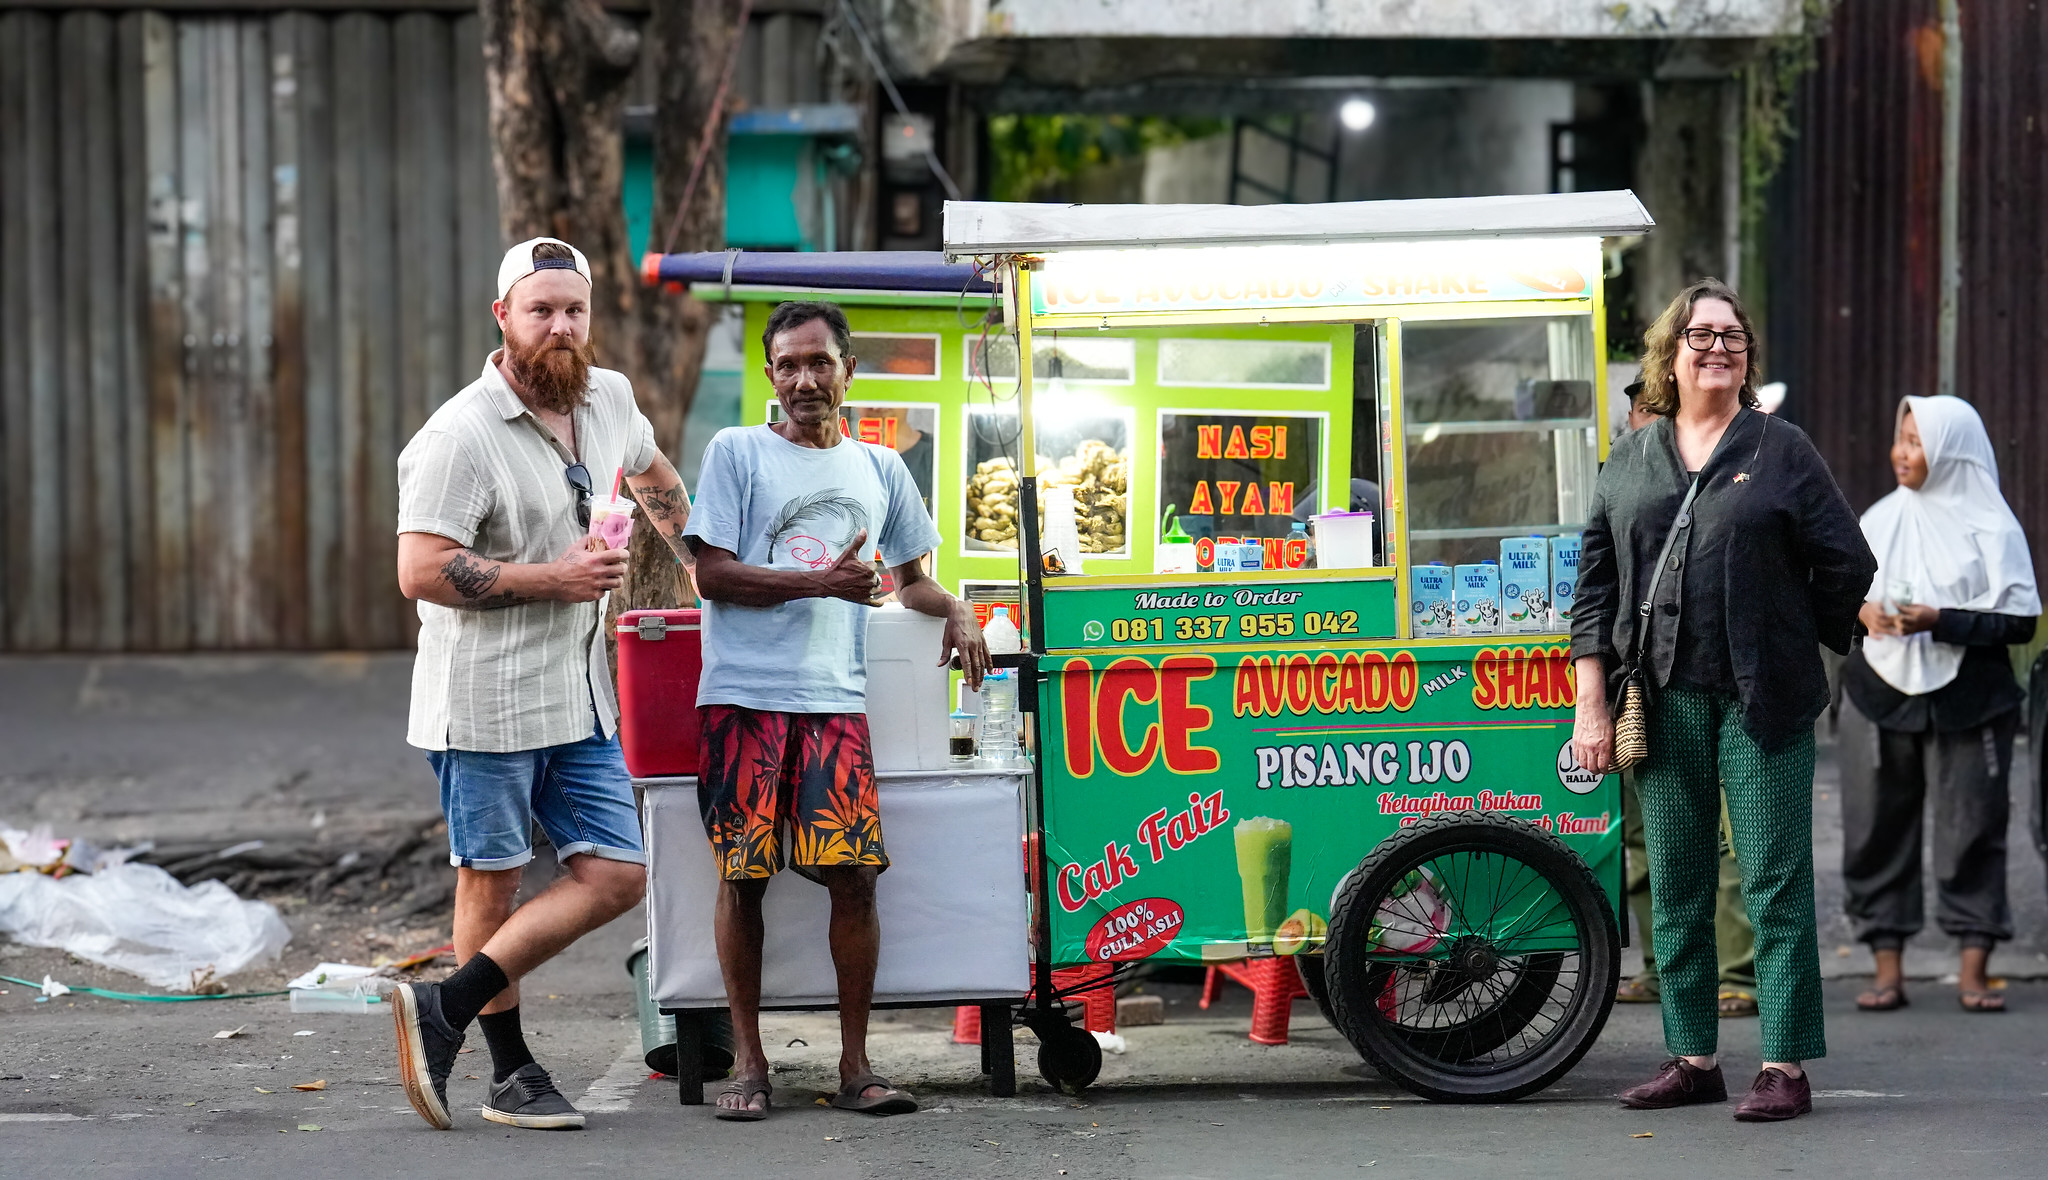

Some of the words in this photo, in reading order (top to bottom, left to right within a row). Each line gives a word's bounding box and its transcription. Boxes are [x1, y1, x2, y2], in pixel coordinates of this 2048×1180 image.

[1362, 270, 1489, 297] SHAKE
[839, 416, 898, 450] ASI
[1197, 424, 1287, 459] NASI
[1189, 480, 1294, 516] AYAM
[1217, 558, 1235, 567] ULTRA
[1508, 551, 1540, 561] ULTRA
[1512, 560, 1537, 569] MILK
[1420, 576, 1443, 584] ULTRA
[1135, 592, 1199, 611] Made
[1203, 591, 1228, 608] to
[1232, 589, 1303, 607] Order
[1111, 618, 1164, 642] 081
[1175, 616, 1231, 640] 337
[1240, 613, 1295, 637] 955
[1303, 610, 1359, 636] 042
[1061, 655, 1221, 779] ICE
[1233, 650, 1419, 718] AVOCADO
[1422, 665, 1467, 698] MILK
[1471, 646, 1577, 710] SHAK
[1256, 742, 1399, 790] PISANG
[1406, 738, 1471, 785] IJO
[1565, 774, 1598, 783] HALAL
[1377, 791, 1474, 818] Ketagihan
[1477, 789, 1542, 811] Bukan
[1556, 811, 1609, 834] Kami
[1057, 840, 1139, 913] Cak
[1137, 789, 1230, 864] Faiz
[1099, 931, 1145, 961] GULA
[1146, 910, 1182, 939] ASLI
[1104, 902, 1155, 939] 100%
